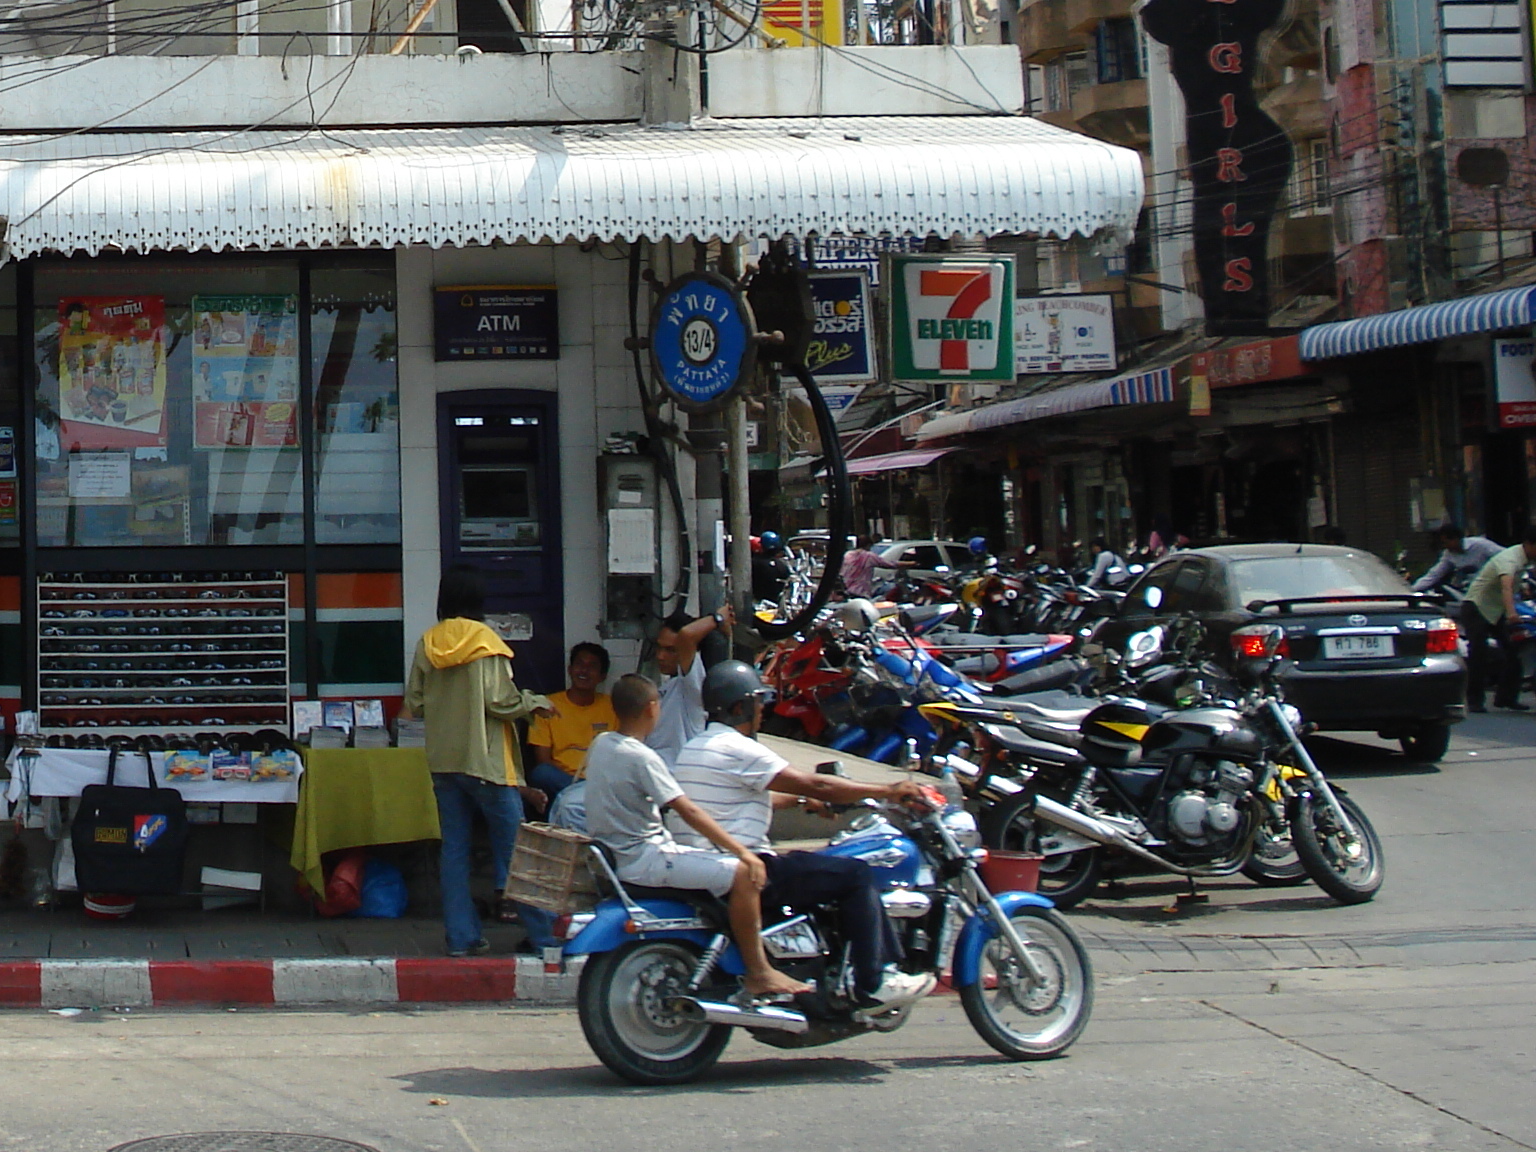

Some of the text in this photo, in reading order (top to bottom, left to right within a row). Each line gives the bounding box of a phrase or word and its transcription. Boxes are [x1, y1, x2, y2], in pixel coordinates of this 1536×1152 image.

[1209, 41, 1256, 292] GIRLS
[477, 315, 520, 331] ATM
[667, 293, 729, 326] พัทยา
[920, 268, 992, 370] 7
[686, 328, 712, 354] 13/4
[804, 339, 853, 368] Plus
[676, 359, 726, 381] PATTAYA
